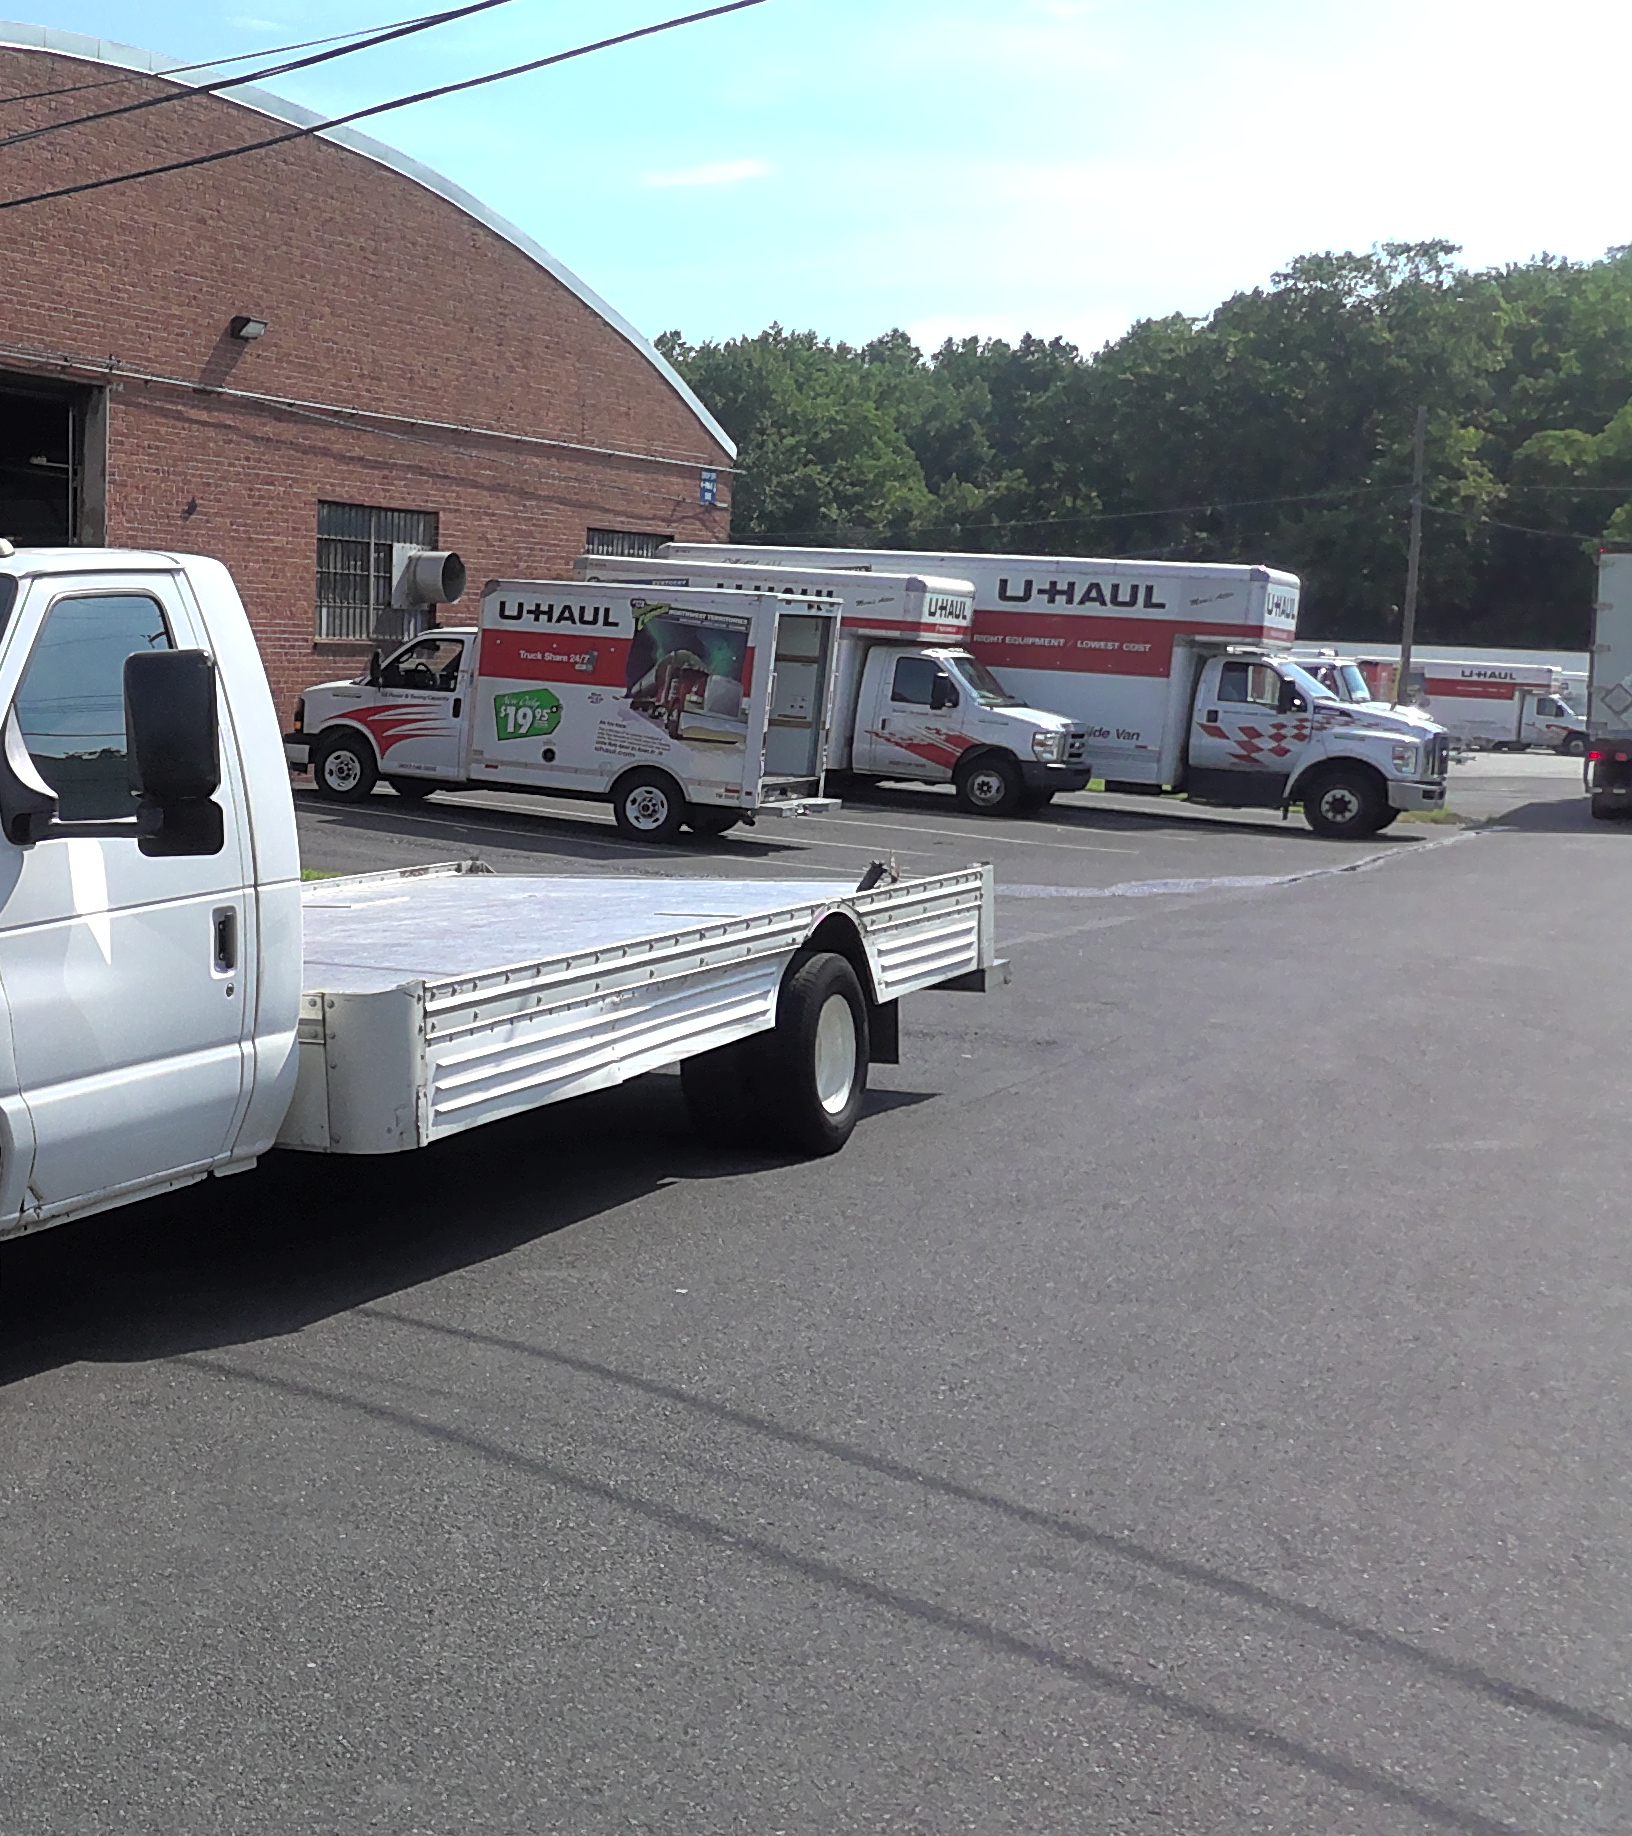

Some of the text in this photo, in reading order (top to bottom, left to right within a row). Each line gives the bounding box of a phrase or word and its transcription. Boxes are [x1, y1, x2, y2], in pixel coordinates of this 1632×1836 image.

[998, 578, 1167, 609] U-HAUL
[498, 600, 620, 628] U-HAUL
[928, 596, 968, 620] U-HAUL
[973, 634, 1004, 644] RIGHT
[1005, 636, 1066, 647] EQUIPMENT
[1077, 640, 1120, 650] LOWEST
[1122, 643, 1152, 652] COST
[519, 650, 590, 663] Truck Share 24/7
[1461, 669, 1517, 681] U-HAUL
[1115, 728, 1141, 741] Van
